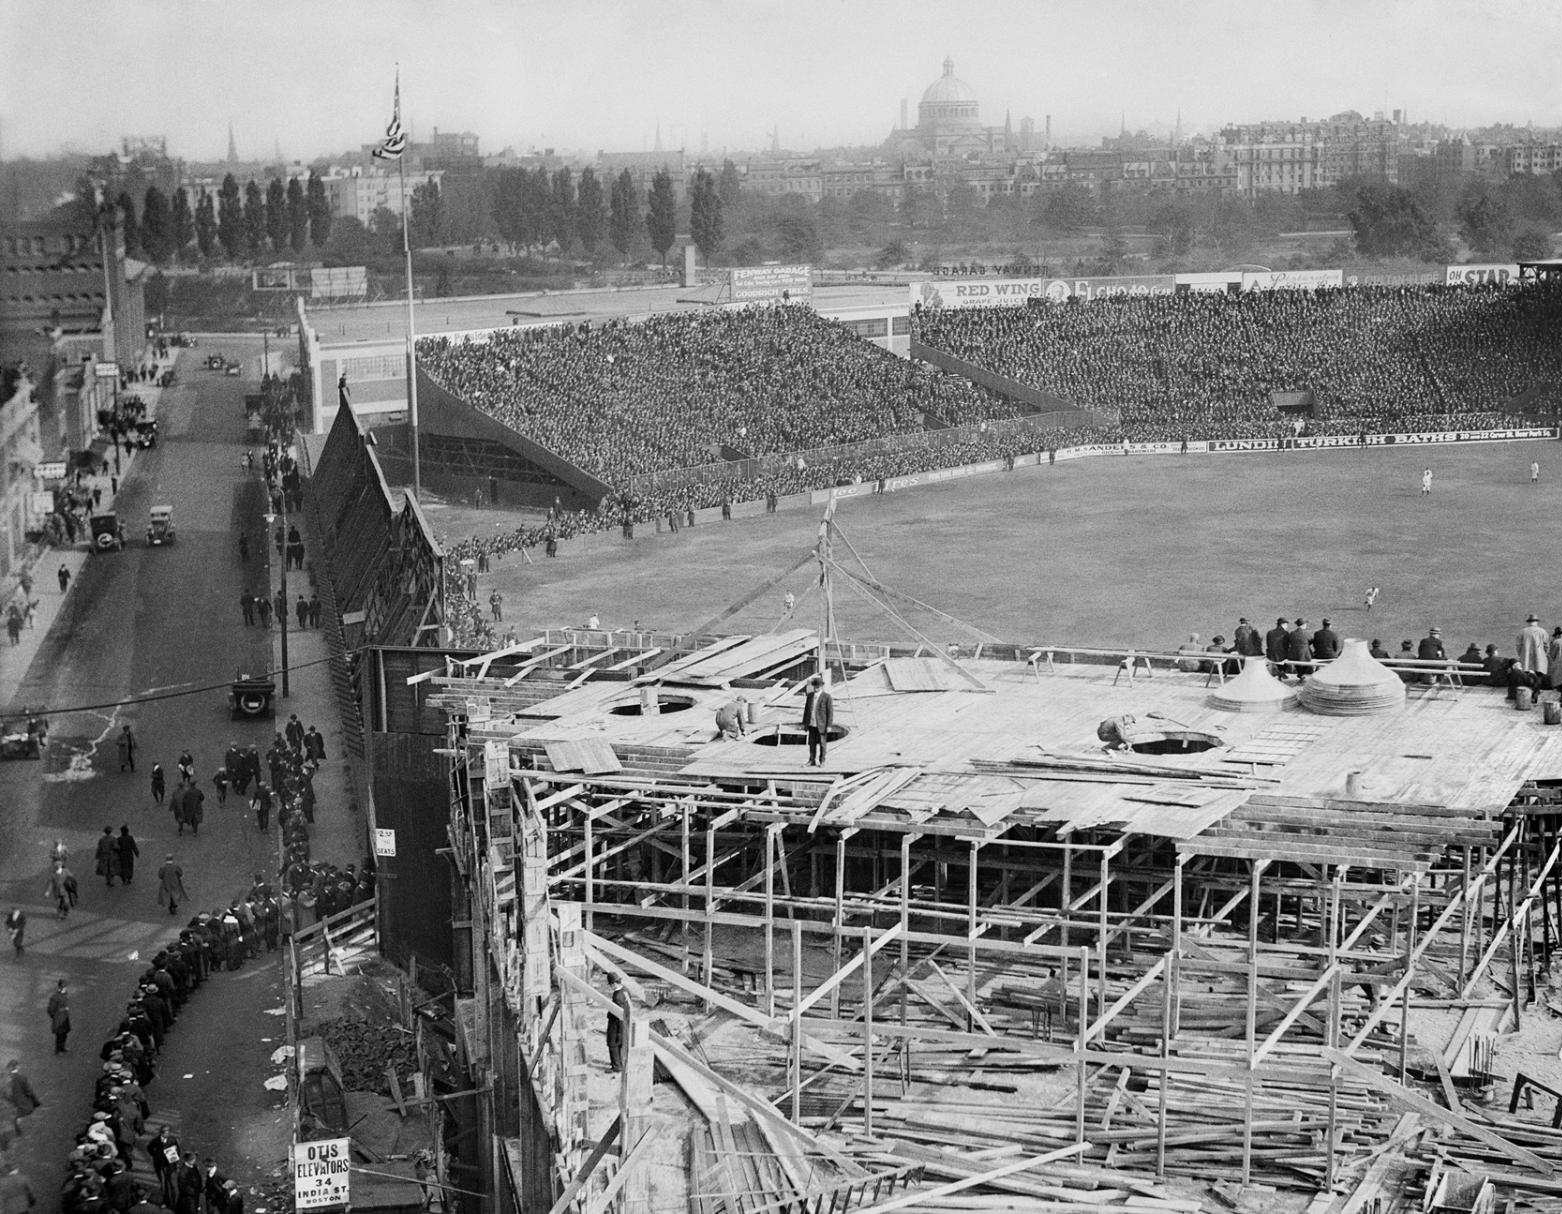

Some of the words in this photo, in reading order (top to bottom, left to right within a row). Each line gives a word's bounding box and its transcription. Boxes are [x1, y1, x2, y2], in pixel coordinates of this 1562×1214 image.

[1449, 270, 1462, 280] OH
[956, 284, 990, 296] RED
[994, 283, 1040, 295] WING
[1395, 432, 1457, 444] BATHS
[308, 1144, 338, 1160] OTIS
[297, 1158, 349, 1178] ELEVATORS
[315, 1177, 332, 1187] 34
[298, 1188, 329, 1199] INDIA
[306, 1195, 341, 1204] BOSTON
